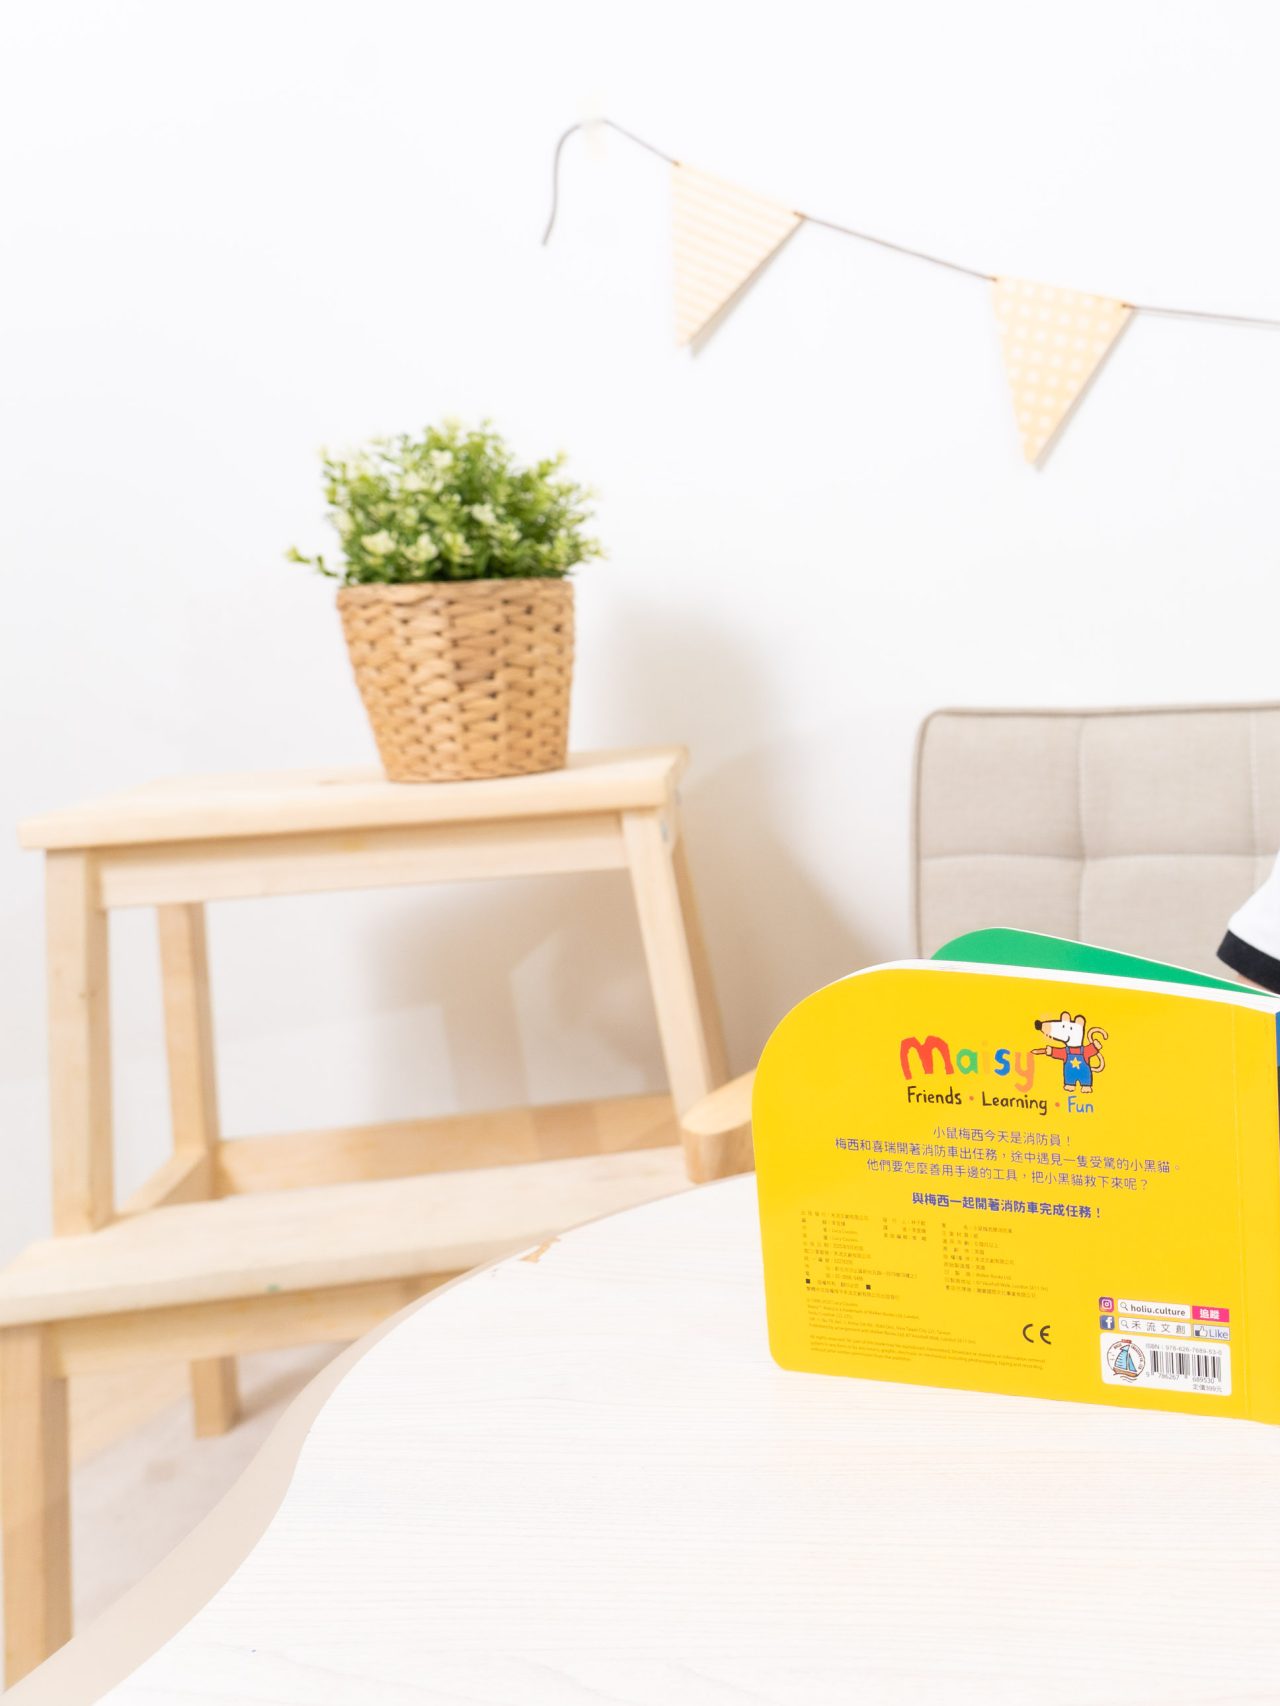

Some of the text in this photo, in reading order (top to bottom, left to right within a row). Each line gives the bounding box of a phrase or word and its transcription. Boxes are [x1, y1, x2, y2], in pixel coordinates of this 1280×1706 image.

[907, 1086, 1095, 1116] Friends Learning Fun
[1130, 1304, 1186, 1316] holiu.culture
[1209, 1329, 1229, 1339] Like
